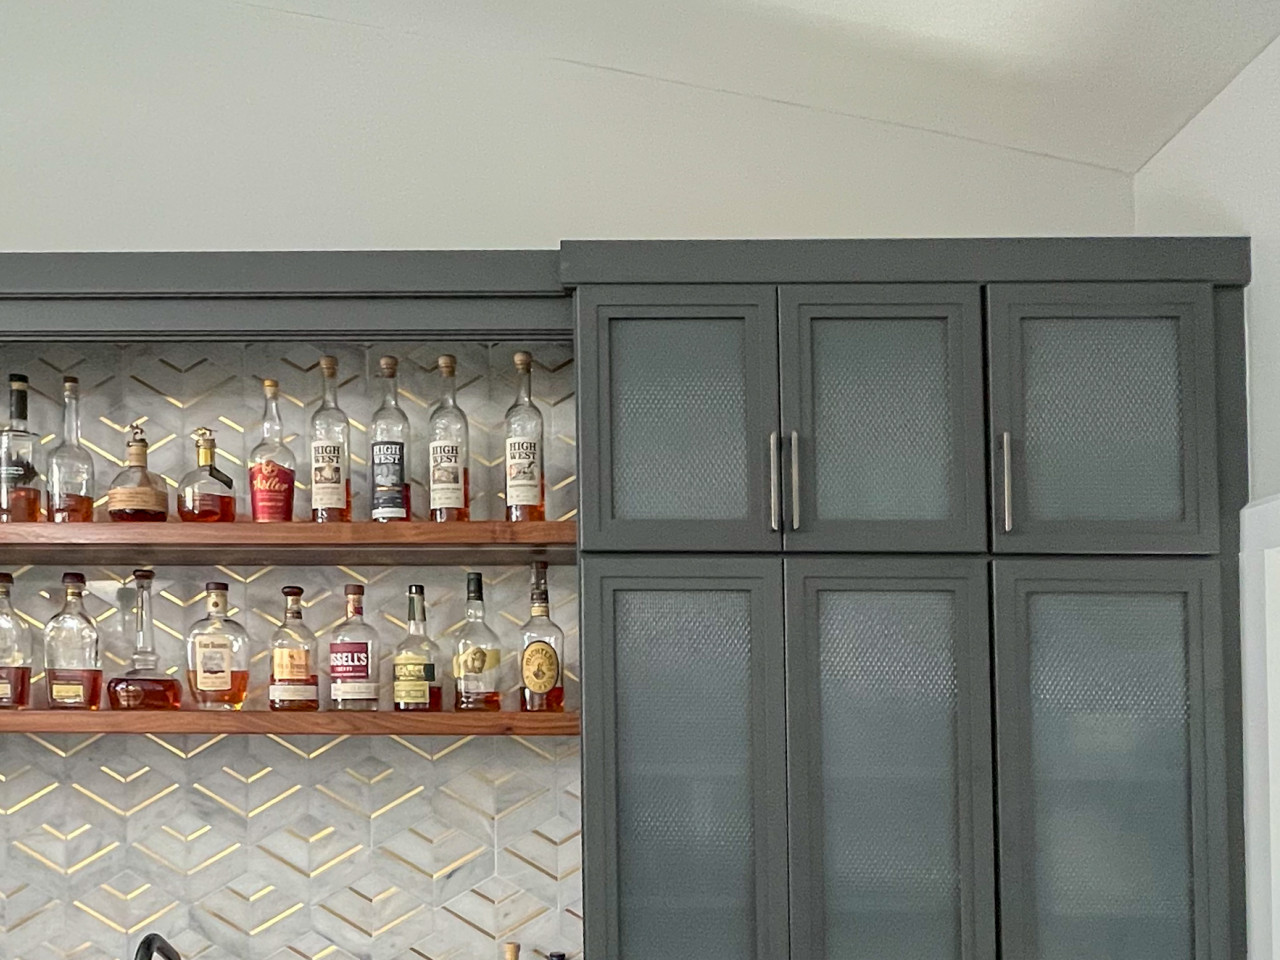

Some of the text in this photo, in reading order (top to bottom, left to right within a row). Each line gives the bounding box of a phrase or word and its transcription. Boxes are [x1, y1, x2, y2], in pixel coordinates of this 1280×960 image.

[314, 445, 340, 454] HIGH
[373, 445, 400, 454] HIGH
[432, 445, 458, 454] HIGH
[509, 442, 536, 451] HIGH
[314, 455, 340, 464] WEST
[373, 455, 400, 464] WEST
[432, 455, 458, 464] WEST
[509, 452, 536, 460] WEST
